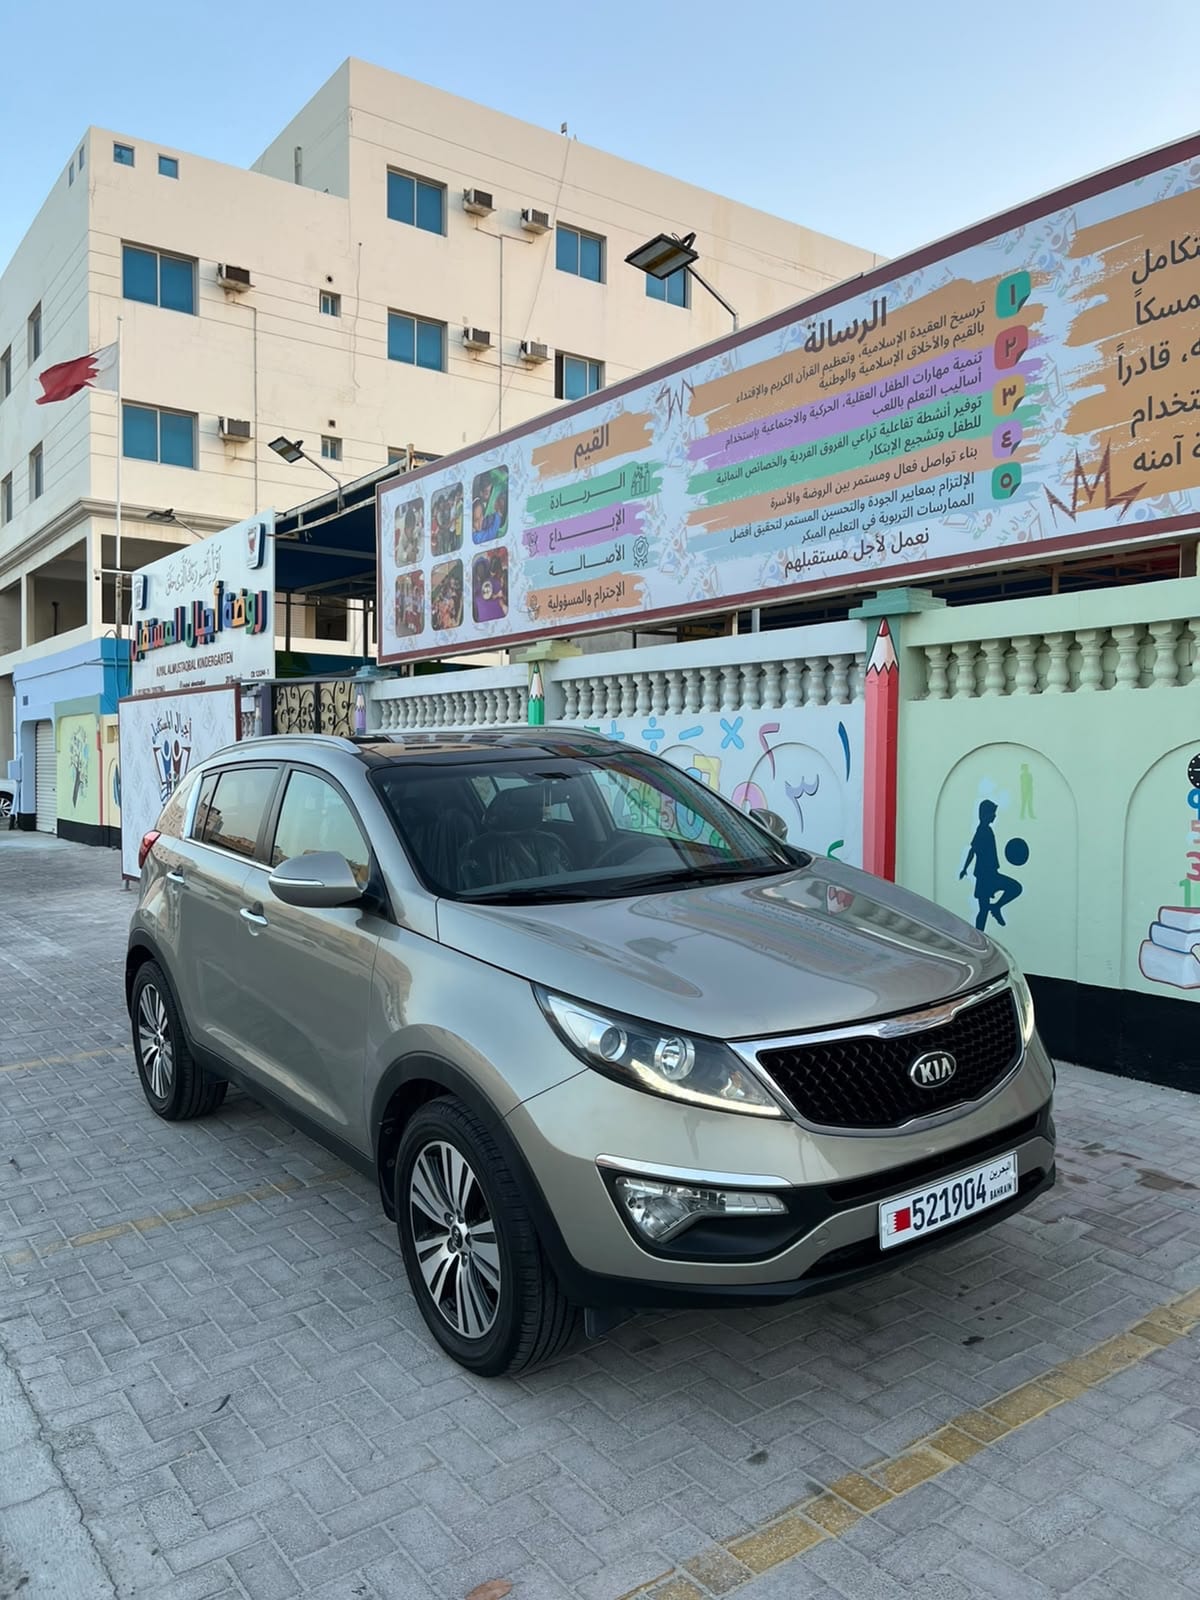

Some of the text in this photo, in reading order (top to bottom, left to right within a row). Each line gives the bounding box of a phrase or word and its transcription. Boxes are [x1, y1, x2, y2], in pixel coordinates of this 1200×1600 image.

[804, 296, 887, 353] الرسالة
[950, 301, 986, 329] ترسيخ
[910, 314, 947, 339] العقيدة
[952, 321, 985, 348] بالقيم
[907, 334, 950, 361] والأخلاق
[822, 352, 855, 378] وتعظيم
[859, 349, 904, 376] الإسلامية
[953, 351, 982, 371] تنمية
[770, 373, 794, 394] الكريم
[795, 363, 820, 384] القرآن
[912, 366, 949, 386] مهارات
[872, 367, 982, 417] أساليب التعلم باللعب
[880, 375, 909, 398] الطفل
[810, 398, 839, 420] الحركية
[916, 402, 950, 424] أنشطة
[954, 395, 982, 418] توفير
[851, 428, 876, 447] تراعي
[879, 417, 913, 439] تفاعلية
[948, 415, 982, 438] للطفل
[573, 424, 609, 468] القيم
[820, 435, 849, 456] الفروق
[904, 428, 944, 453] وتشجيع
[790, 445, 817, 463] الفردية
[920, 452, 955, 473] تواصل
[959, 445, 978, 461] بناء
[745, 456, 787, 478] والخصائص
[893, 460, 917, 479] فعال
[803, 482, 832, 500] الروضة
[835, 479, 850, 495] بين
[852, 471, 890, 490] ومستمر
[868, 490, 898, 508] الجودة
[901, 483, 935, 502] بمعايير
[784, 509, 819, 530] المستمر
[802, 493, 974, 544] الممارسات التربوية في التعليم المبكر
[821, 499, 865, 521] والتحسين
[729, 523, 752, 543] أفضل
[753, 517, 782, 538] لتحقيق
[785, 527, 929, 578] نعمل لأجل مستقبلهم
[223, 587, 267, 635] روضة
[547, 588, 591, 612] والمسؤولية
[184, 579, 224, 648] أجيال
[130, 605, 186, 662] المستقبل
[197, 651, 234, 669] KINDERGARTEN
[918, 1056, 952, 1084] KIA
[989, 1161, 1012, 1181] البحرين
[911, 1172, 987, 1231] 521904
[990, 1182, 1012, 1201] BAHRAIN
